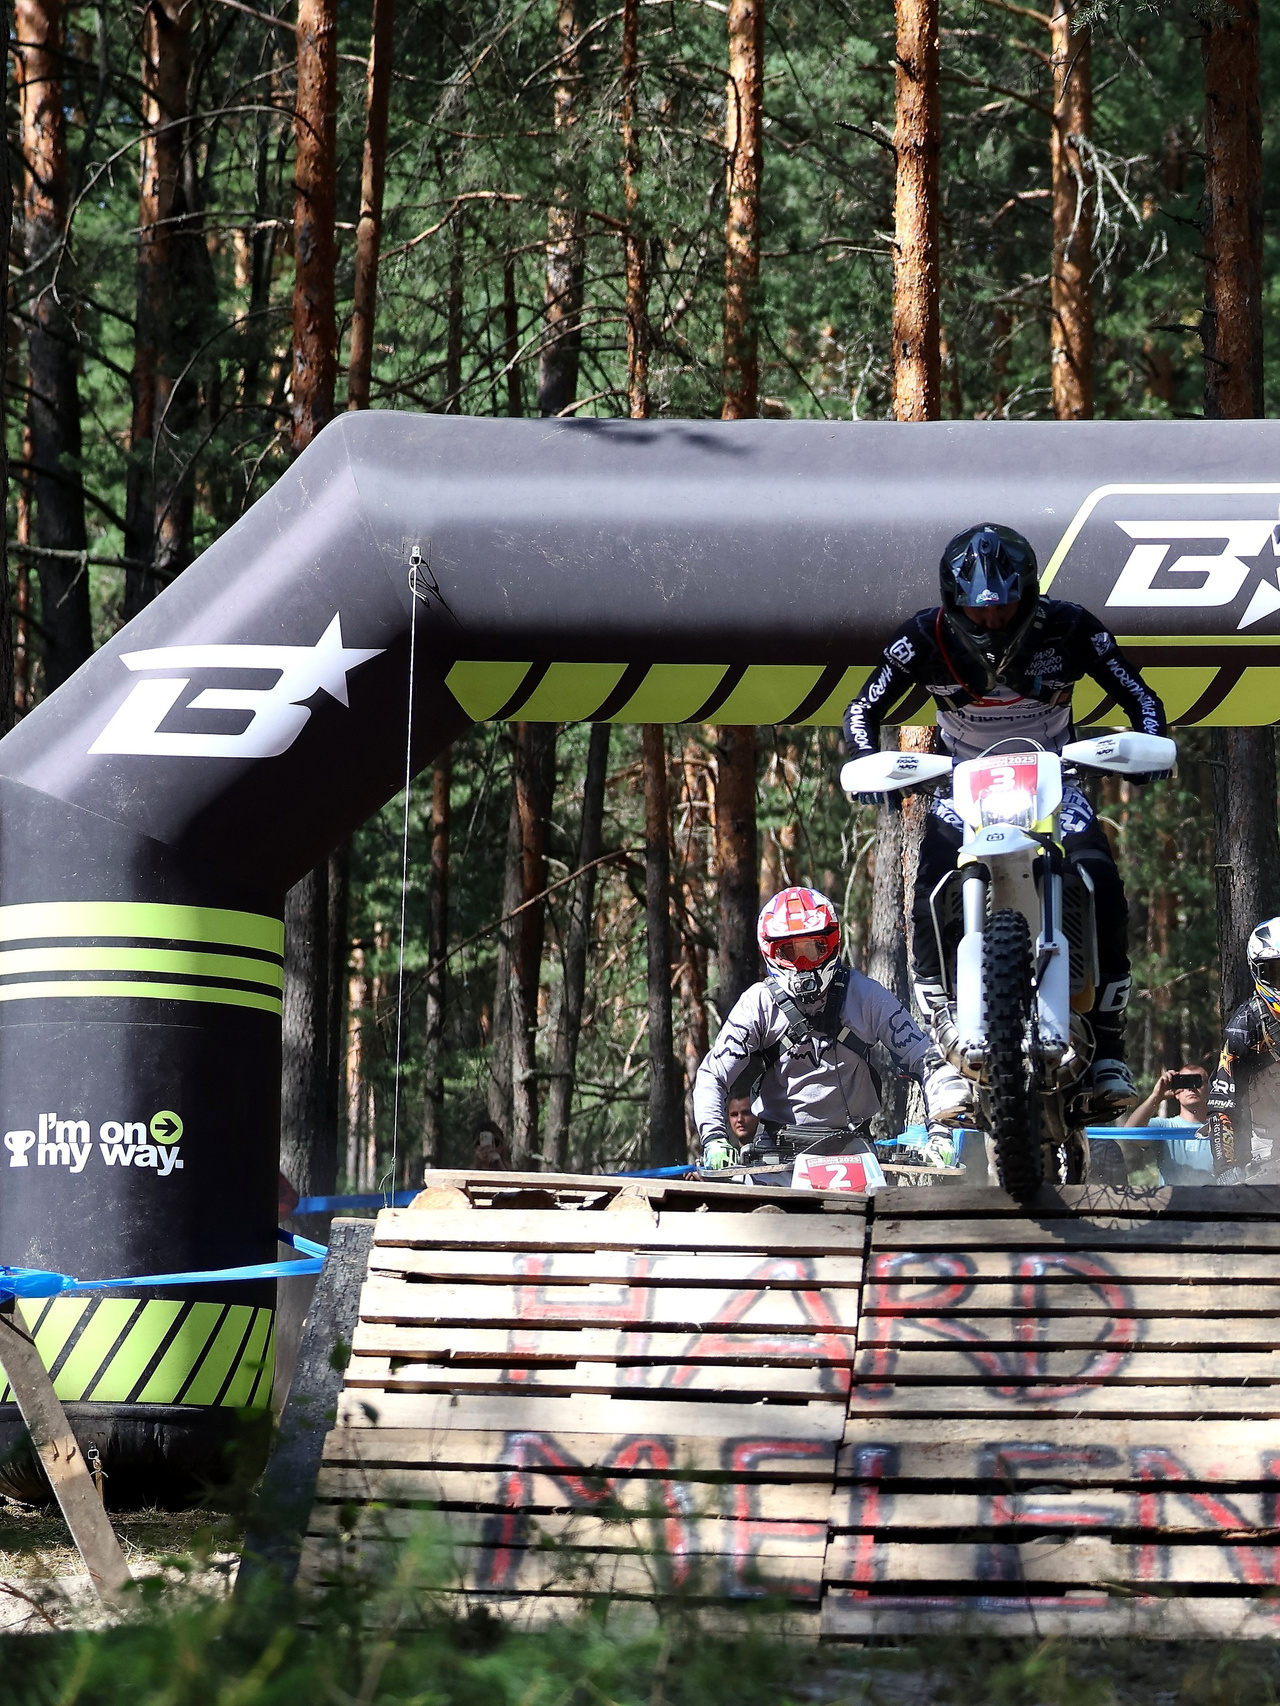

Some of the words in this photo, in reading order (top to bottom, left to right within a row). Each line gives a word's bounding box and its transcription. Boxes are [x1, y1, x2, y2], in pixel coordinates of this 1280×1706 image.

[989, 766, 1016, 791] 3
[99, 1121, 147, 1144] on
[37, 1142, 93, 1173] my
[99, 1144, 184, 1176] way.
[825, 1164, 852, 1188] 2
[502, 1250, 1148, 1402] HARD
